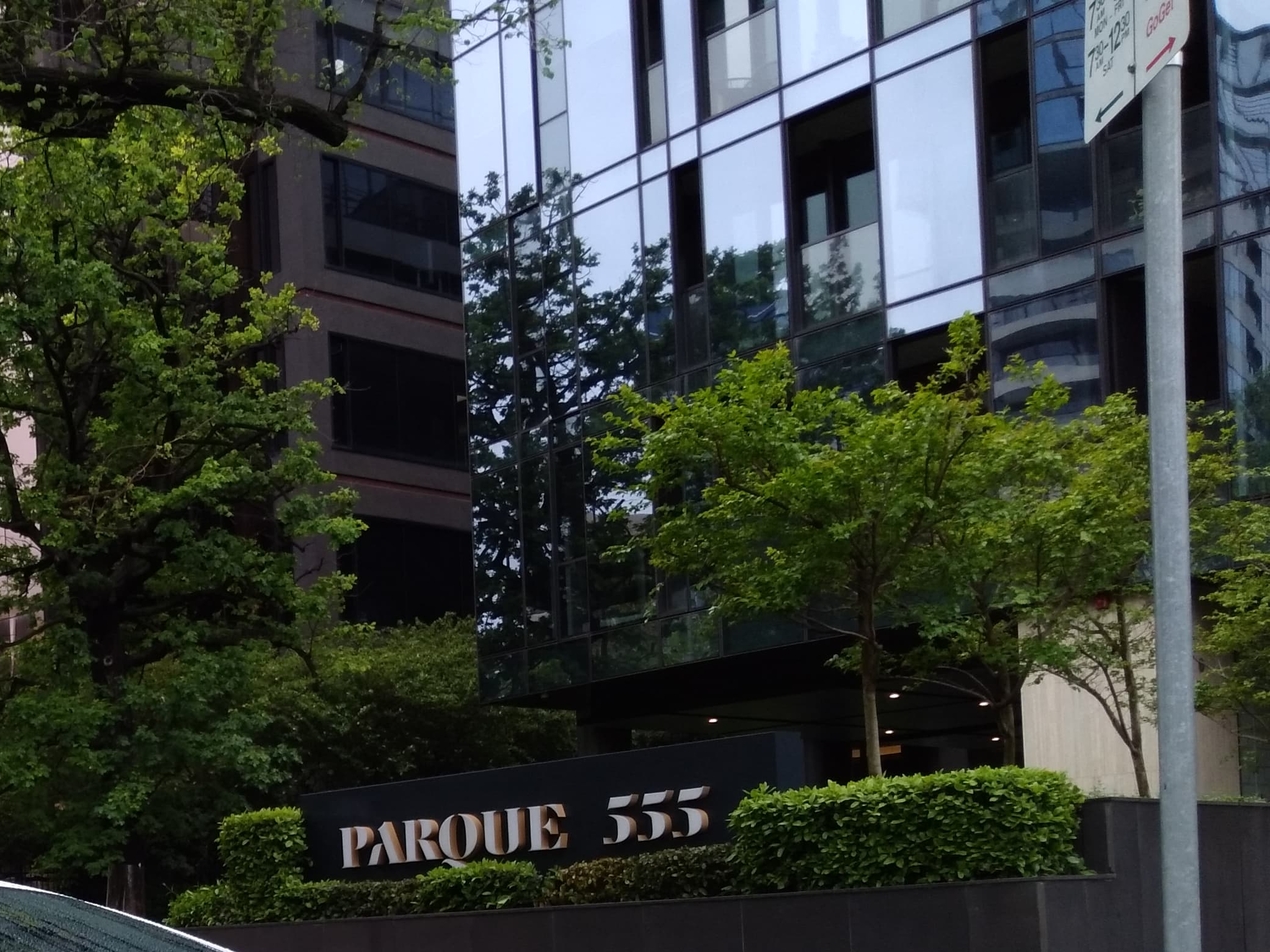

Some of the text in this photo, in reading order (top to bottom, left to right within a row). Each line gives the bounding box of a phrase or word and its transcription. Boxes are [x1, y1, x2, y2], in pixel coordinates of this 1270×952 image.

[1102, 55, 1115, 77] SAT
[338, 785, 711, 870] PARQUE 555
